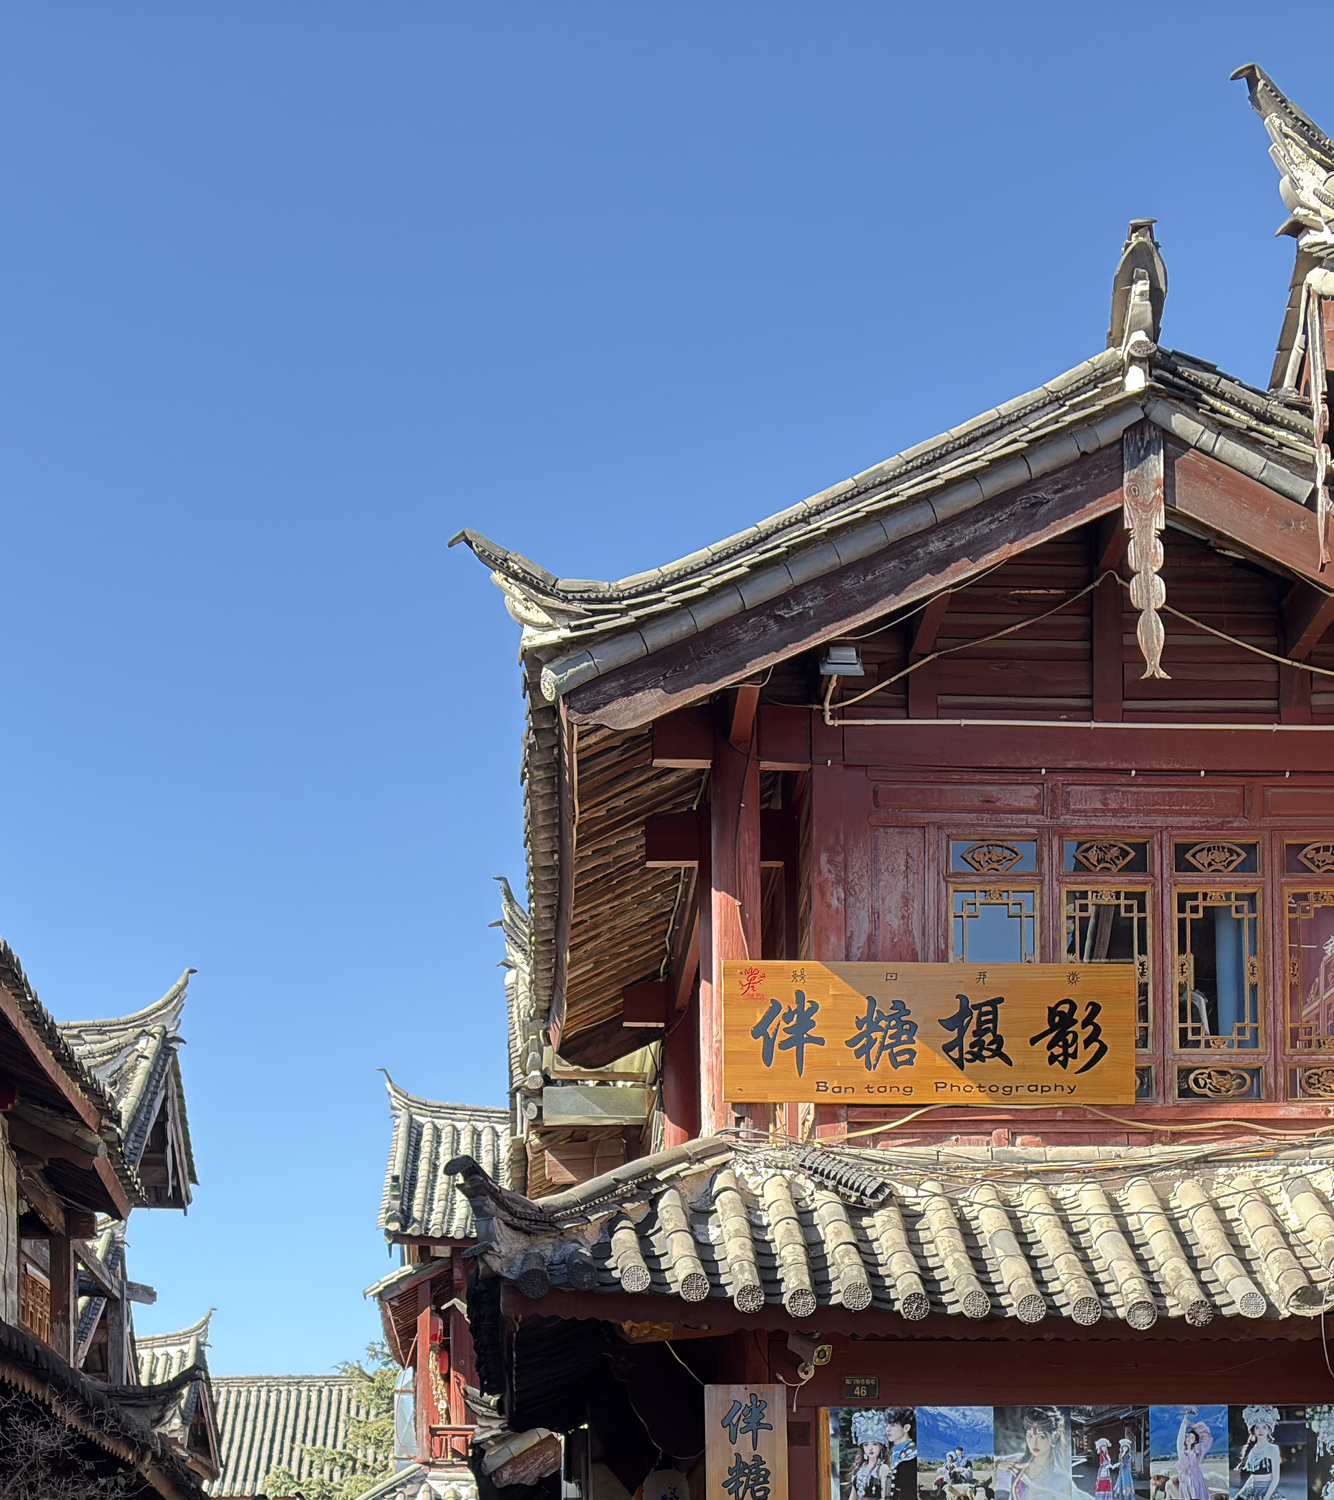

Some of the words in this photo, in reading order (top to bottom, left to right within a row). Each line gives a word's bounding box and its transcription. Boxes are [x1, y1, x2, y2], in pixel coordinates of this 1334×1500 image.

[751, 989, 1109, 1077] 伴糖摄影
[934, 1081, 1078, 1097] Photography
[854, 1386, 867, 1397] 46
